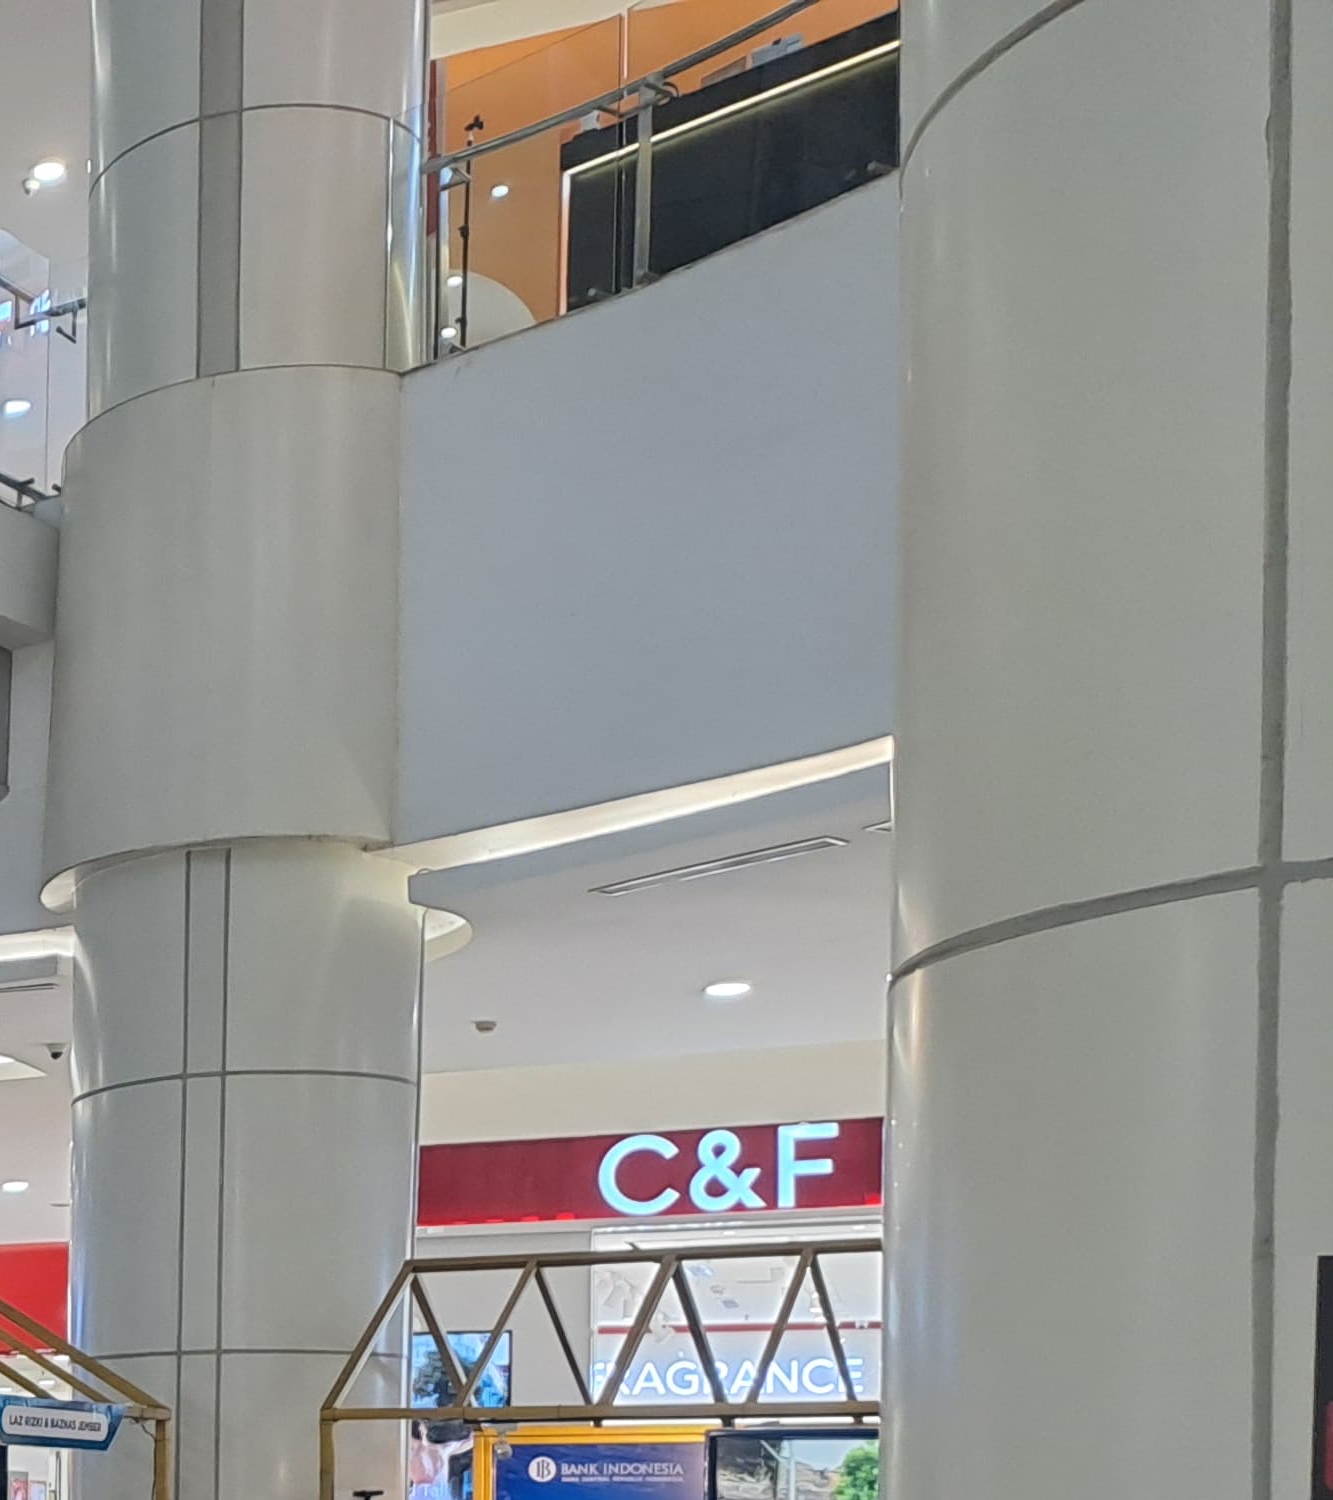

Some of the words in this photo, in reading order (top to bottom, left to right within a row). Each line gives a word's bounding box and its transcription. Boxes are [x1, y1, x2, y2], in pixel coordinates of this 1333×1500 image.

[598, 1121, 840, 1216] C&F
[591, 1357, 864, 1397] FRAGRANCE
[561, 1462, 598, 1476] BANK
[603, 1462, 684, 1476] INDONESIA
